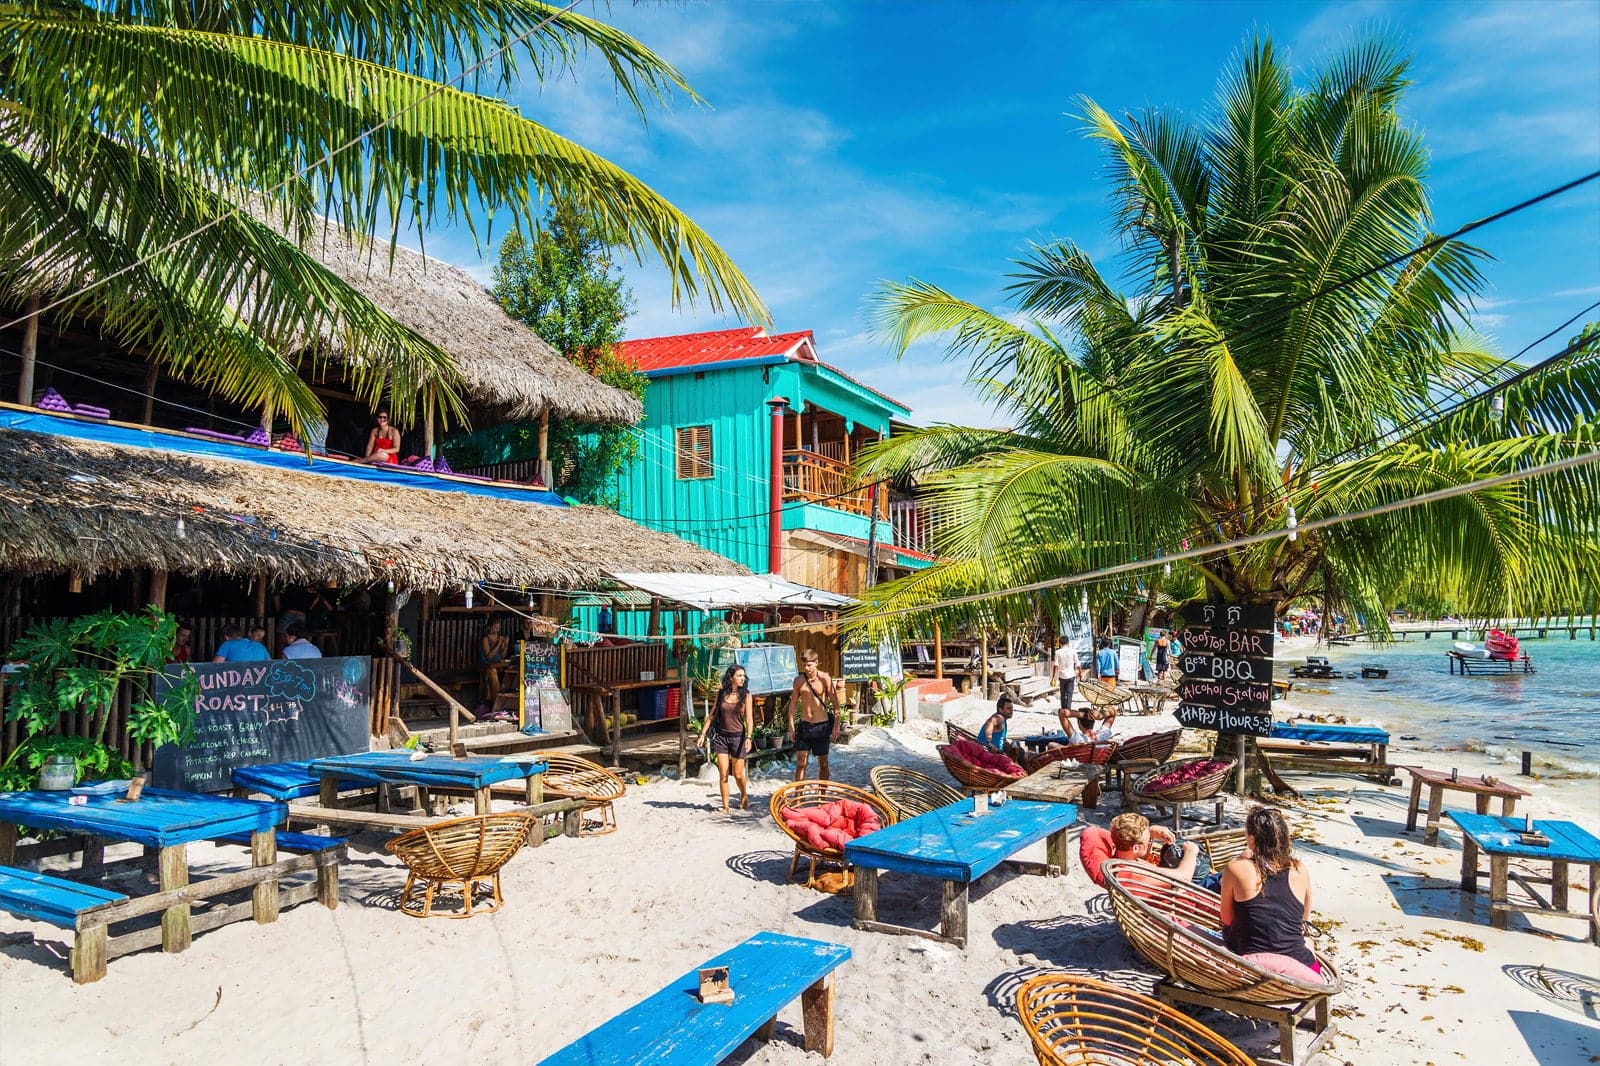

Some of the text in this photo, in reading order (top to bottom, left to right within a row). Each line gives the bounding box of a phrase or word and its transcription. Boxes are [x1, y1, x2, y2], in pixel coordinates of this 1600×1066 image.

[1229, 631, 1268, 655] BAR
[1185, 656, 1255, 680] Best BBQ
[195, 694, 266, 714] ROAST
